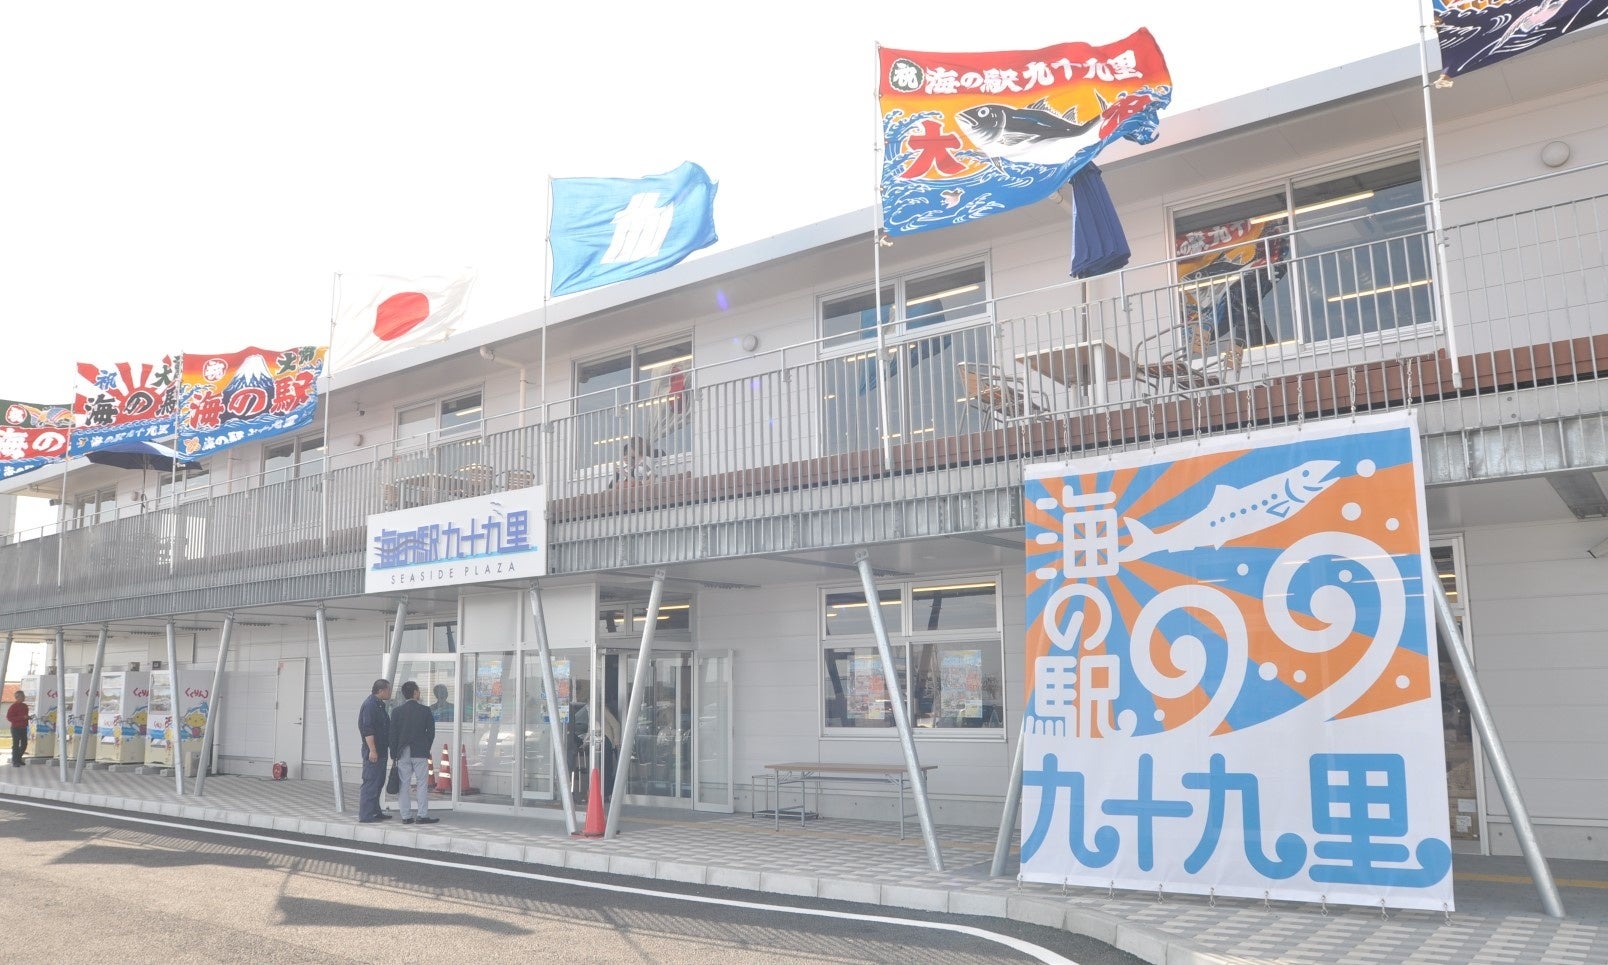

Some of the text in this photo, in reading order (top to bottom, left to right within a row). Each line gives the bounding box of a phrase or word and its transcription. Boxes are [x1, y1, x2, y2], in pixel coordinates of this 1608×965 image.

[923, 49, 1144, 95] 海の駅九十九里
[189, 370, 315, 430] 海の駅
[373, 510, 532, 570] 海の駅九十九里
[391, 562, 516, 585] SEASIDE PLAZA
[1025, 485, 1138, 738] 海の駅
[1020, 752, 1452, 888] 九十九里
